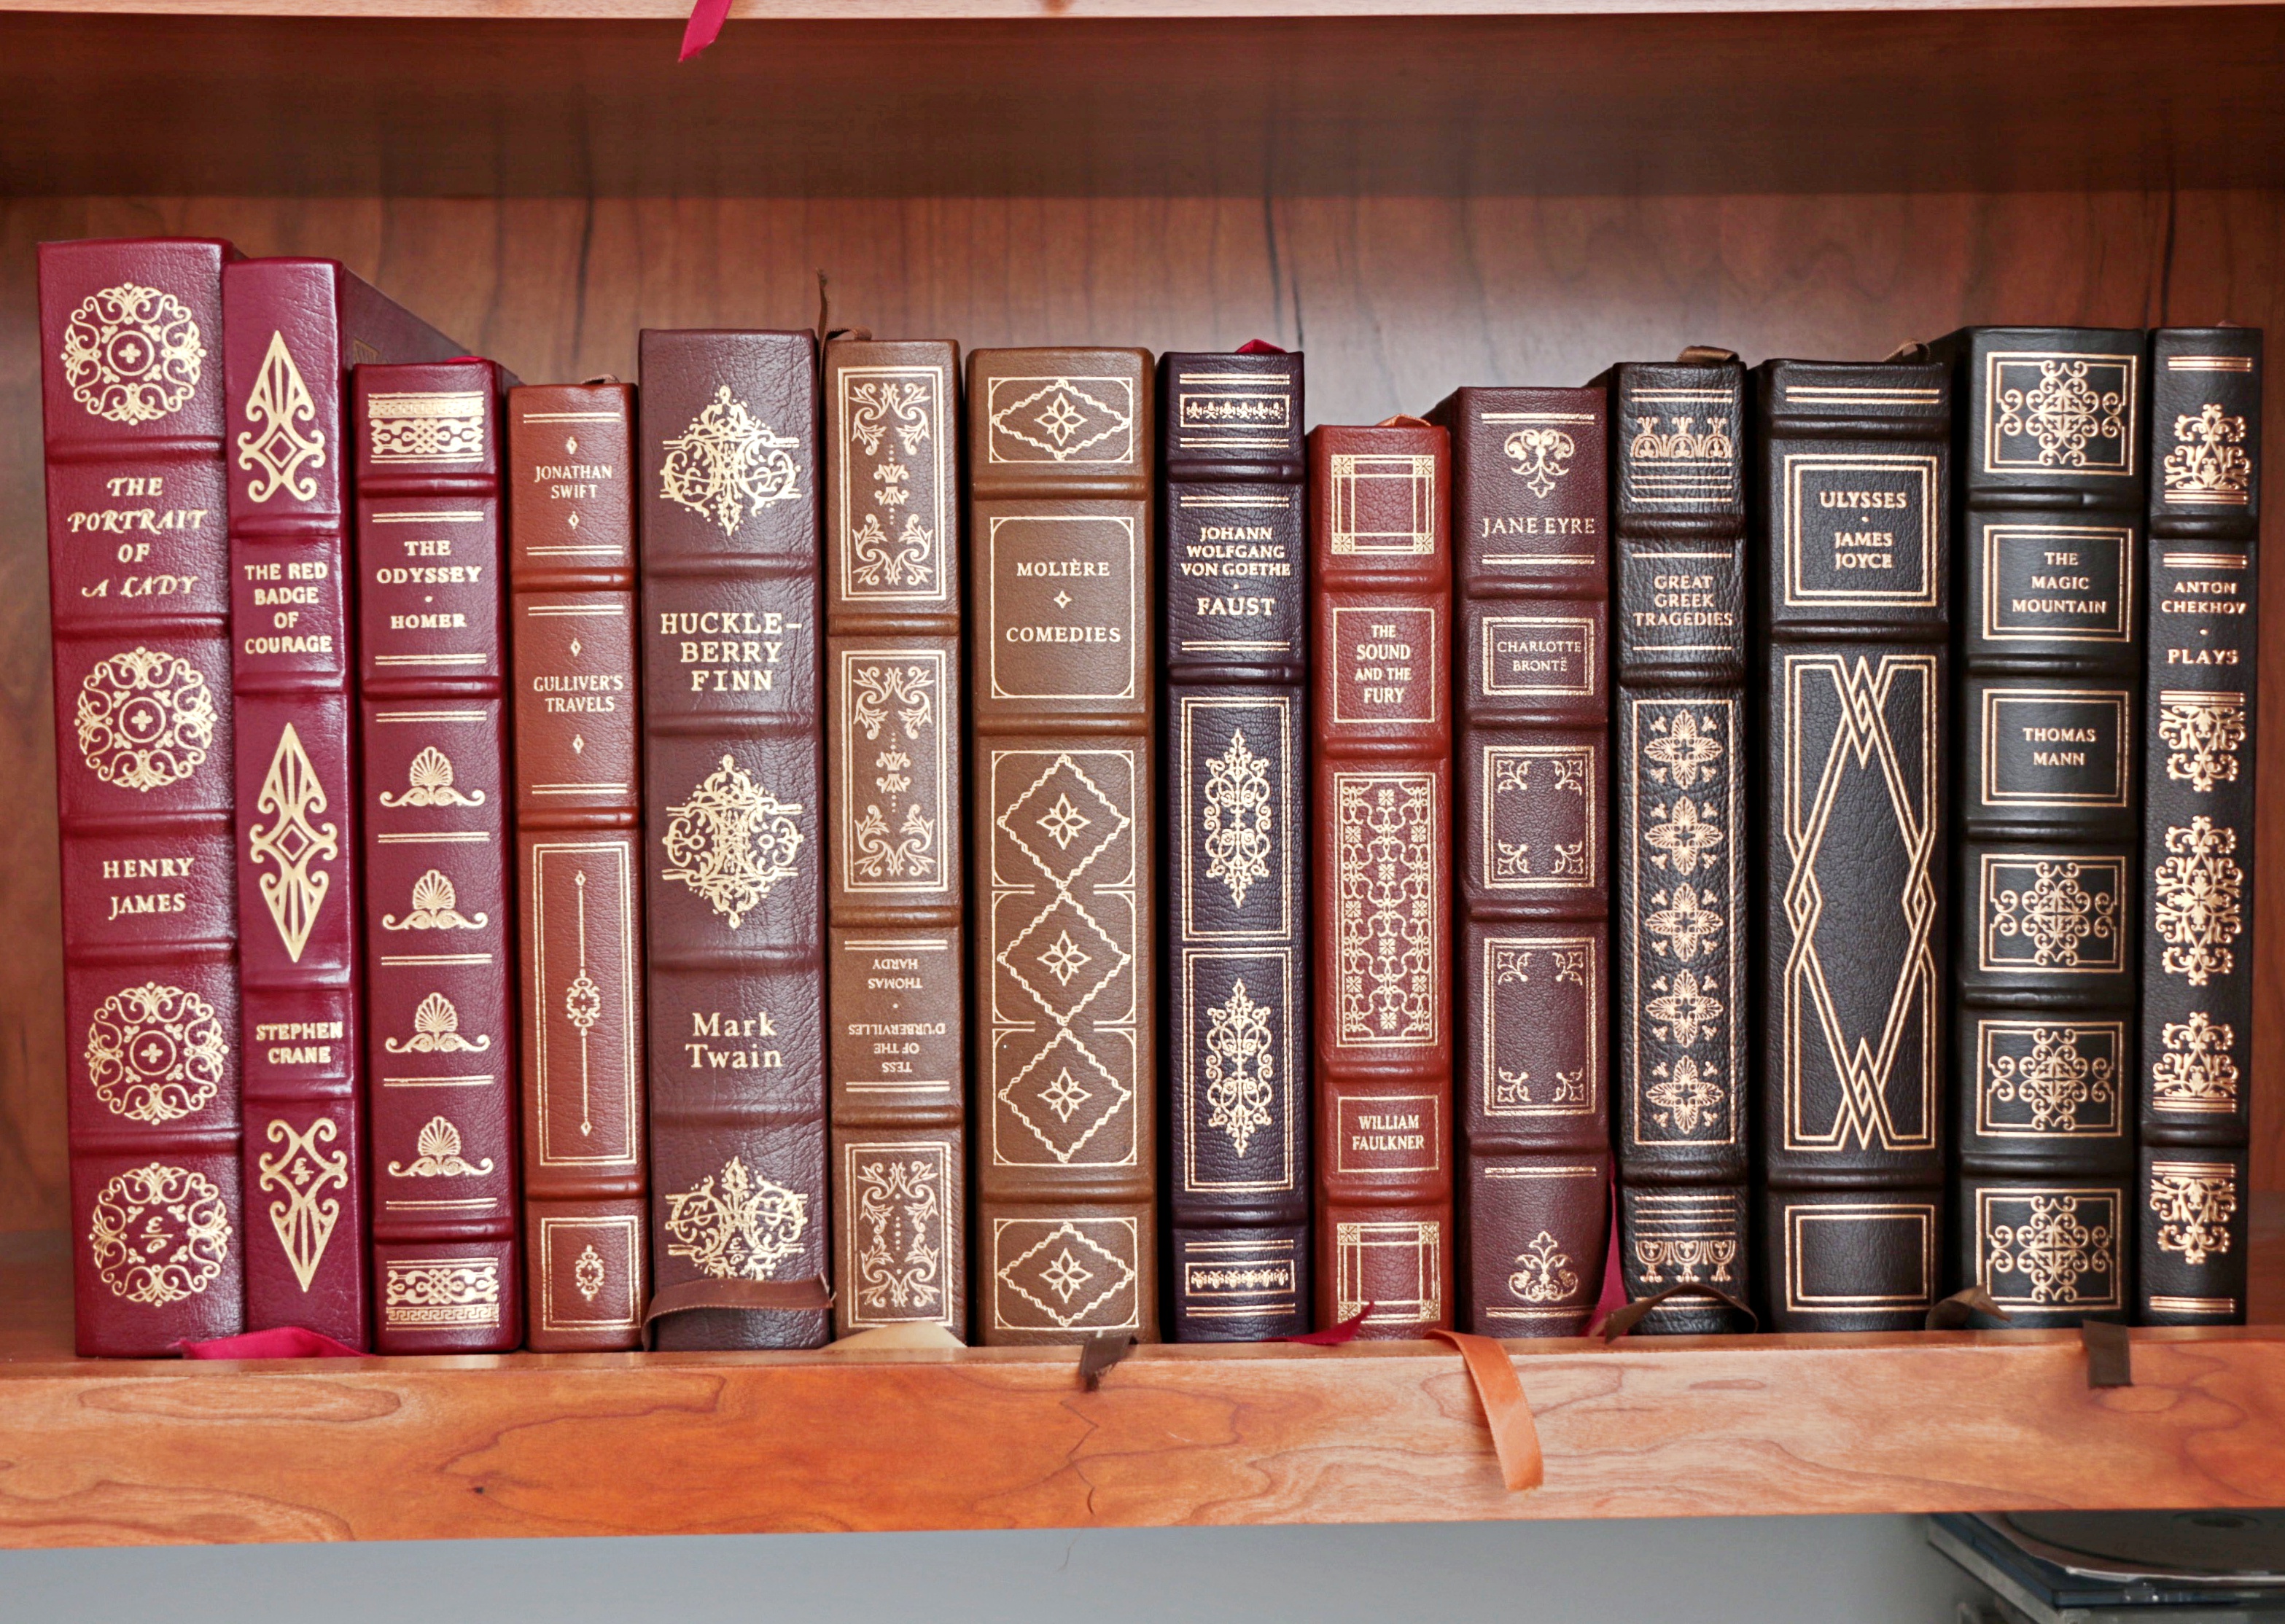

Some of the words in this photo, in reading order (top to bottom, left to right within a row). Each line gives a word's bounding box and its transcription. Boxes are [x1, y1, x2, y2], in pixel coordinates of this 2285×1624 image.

[534, 465, 612, 483] JONATHAN
[106, 477, 163, 497] THE
[551, 484, 598, 499] SWIFT
[1820, 491, 1908, 510] ULYSSES
[68, 509, 209, 535] PORTRAIT
[1482, 517, 1538, 538] JANE
[1544, 518, 1595, 534] EYRE
[1200, 527, 1272, 542] JOHANN
[1834, 532, 1893, 549] JAMES
[117, 544, 150, 562] OF
[405, 540, 451, 556] THE
[1186, 544, 1285, 559] WOLFGANG
[1835, 553, 1893, 569] JOYCE
[2044, 552, 2079, 566] THE
[245, 563, 282, 581] THE
[288, 563, 328, 579] RED
[376, 566, 482, 584] ODYSSEY
[1016, 558, 1110, 577] MOLIÈRE
[1181, 563, 1219, 577] VON
[1223, 562, 1291, 577] GOETHE
[82, 577, 109, 597] A
[120, 575, 198, 596] LADY
[1654, 576, 1713, 590] GREAT
[2031, 576, 2090, 591] MAGIC
[2173, 581, 2237, 595] ANTON
[254, 587, 319, 606] BADGE
[1654, 593, 1715, 608] GREEK
[1197, 597, 1275, 616] FAUST
[2012, 599, 2107, 614] MOUNTAIN
[2160, 600, 2247, 614] CHEKHOV
[273, 612, 299, 628] OF
[390, 614, 467, 629] HOMER
[661, 612, 802, 635] HUCKLE-
[1632, 612, 1733, 627] TRAGEDIES
[1006, 626, 1121, 643] COMEDIES
[1371, 625, 1396, 639] THE
[245, 636, 332, 655] COURAGE
[680, 641, 784, 663] BERRY
[1357, 644, 1411, 660] SOUND
[1497, 640, 1582, 654] CHARLOTTE
[1512, 657, 1568, 671] BRONTË
[2167, 649, 2239, 665] PLAYS
[691, 670, 774, 692] FINN
[1355, 668, 1383, 682] AND
[1387, 667, 1412, 682] THE
[533, 675, 623, 692] GULLIVER'S
[1363, 687, 1405, 704] FURY
[545, 696, 615, 713] TRAVELS
[2023, 727, 2096, 743] THOMAS
[2033, 752, 2085, 766] MANN
[103, 857, 195, 878] HENRY
[108, 893, 186, 920] JAMES
[872, 959, 918, 969] HARDY
[868, 977, 923, 989] THOMAS
[256, 1022, 343, 1041] STEPHEN
[692, 1012, 777, 1037] Mark
[849, 1023, 946, 1035] D'URBERVILLES
[268, 1046, 332, 1064] CRANE
[685, 1043, 783, 1068] Twain
[873, 1043, 900, 1054] THE
[901, 1042, 920, 1054] OF
[881, 1061, 913, 1073] TESS
[1358, 1114, 1420, 1130] WILLIAM
[1352, 1135, 1425, 1150] FAULKNER
